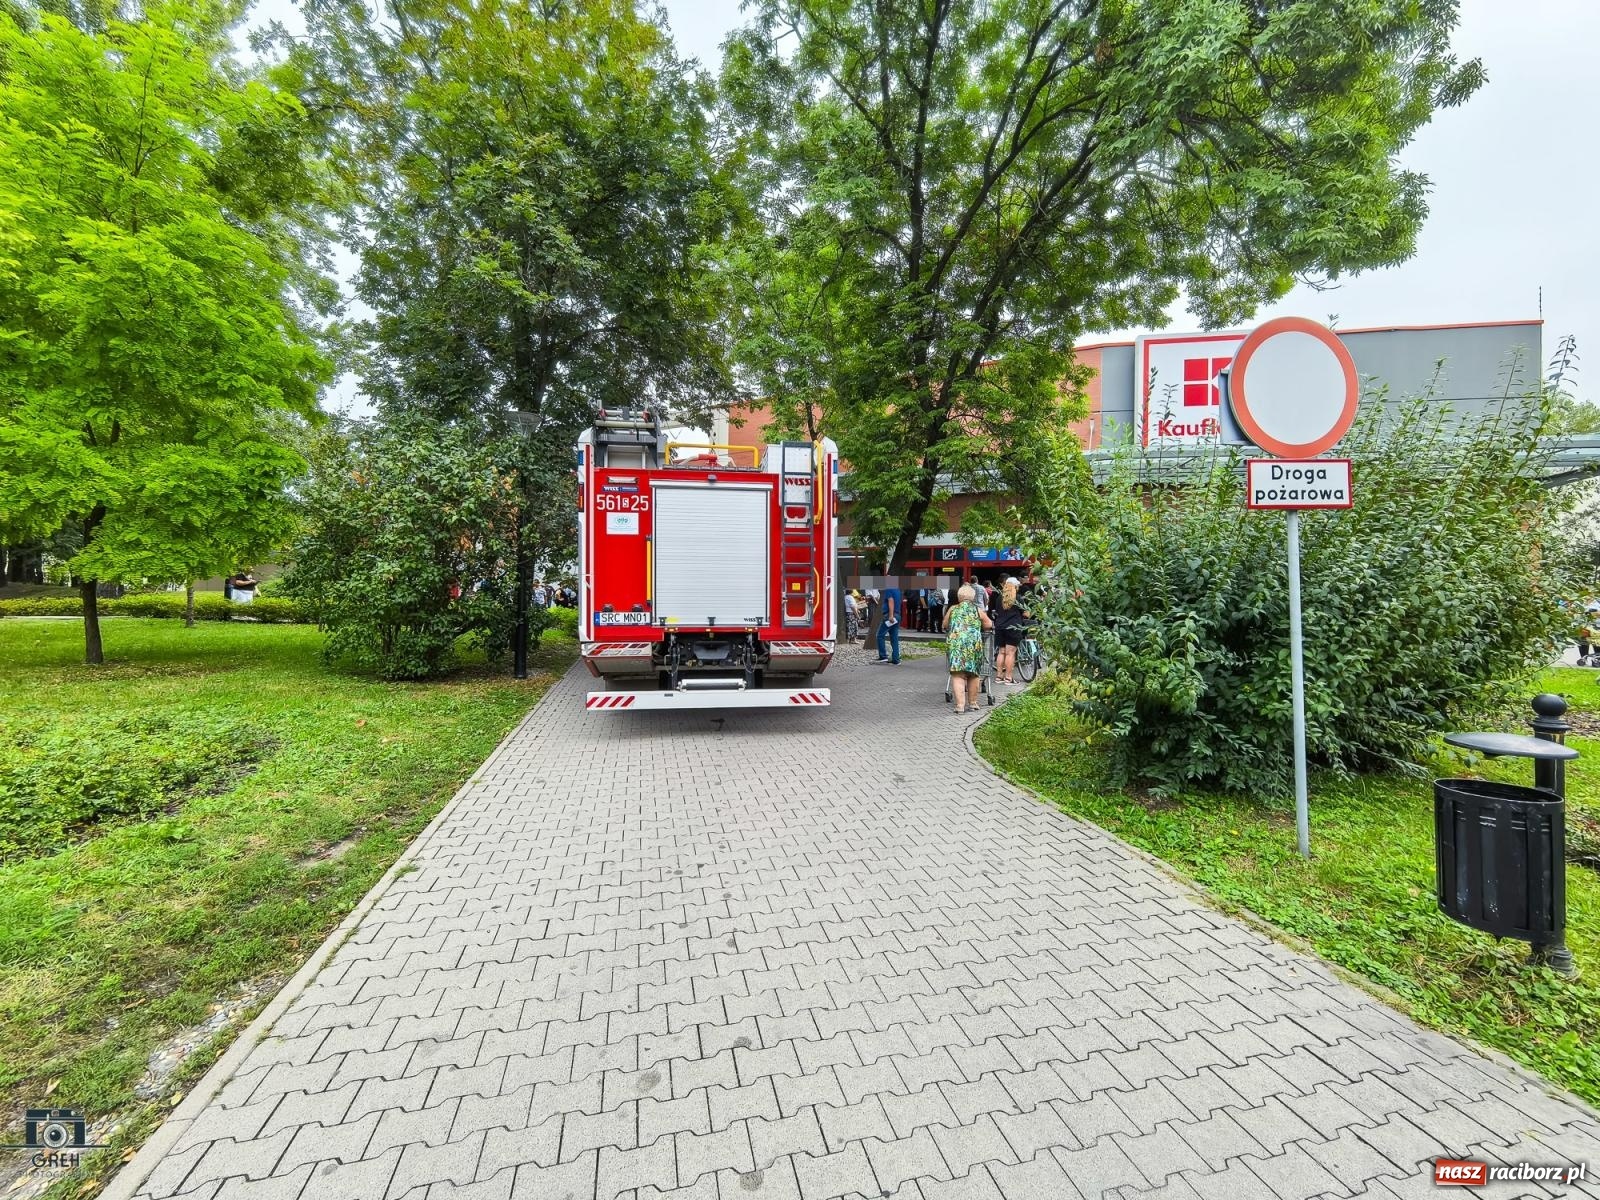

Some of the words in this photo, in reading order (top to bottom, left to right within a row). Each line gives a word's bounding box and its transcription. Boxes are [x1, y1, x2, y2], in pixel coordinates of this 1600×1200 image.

[1271, 465, 1327, 484] Droga
[1255, 485, 1344, 504] pożarowa
[601, 613, 620, 623] SRC
